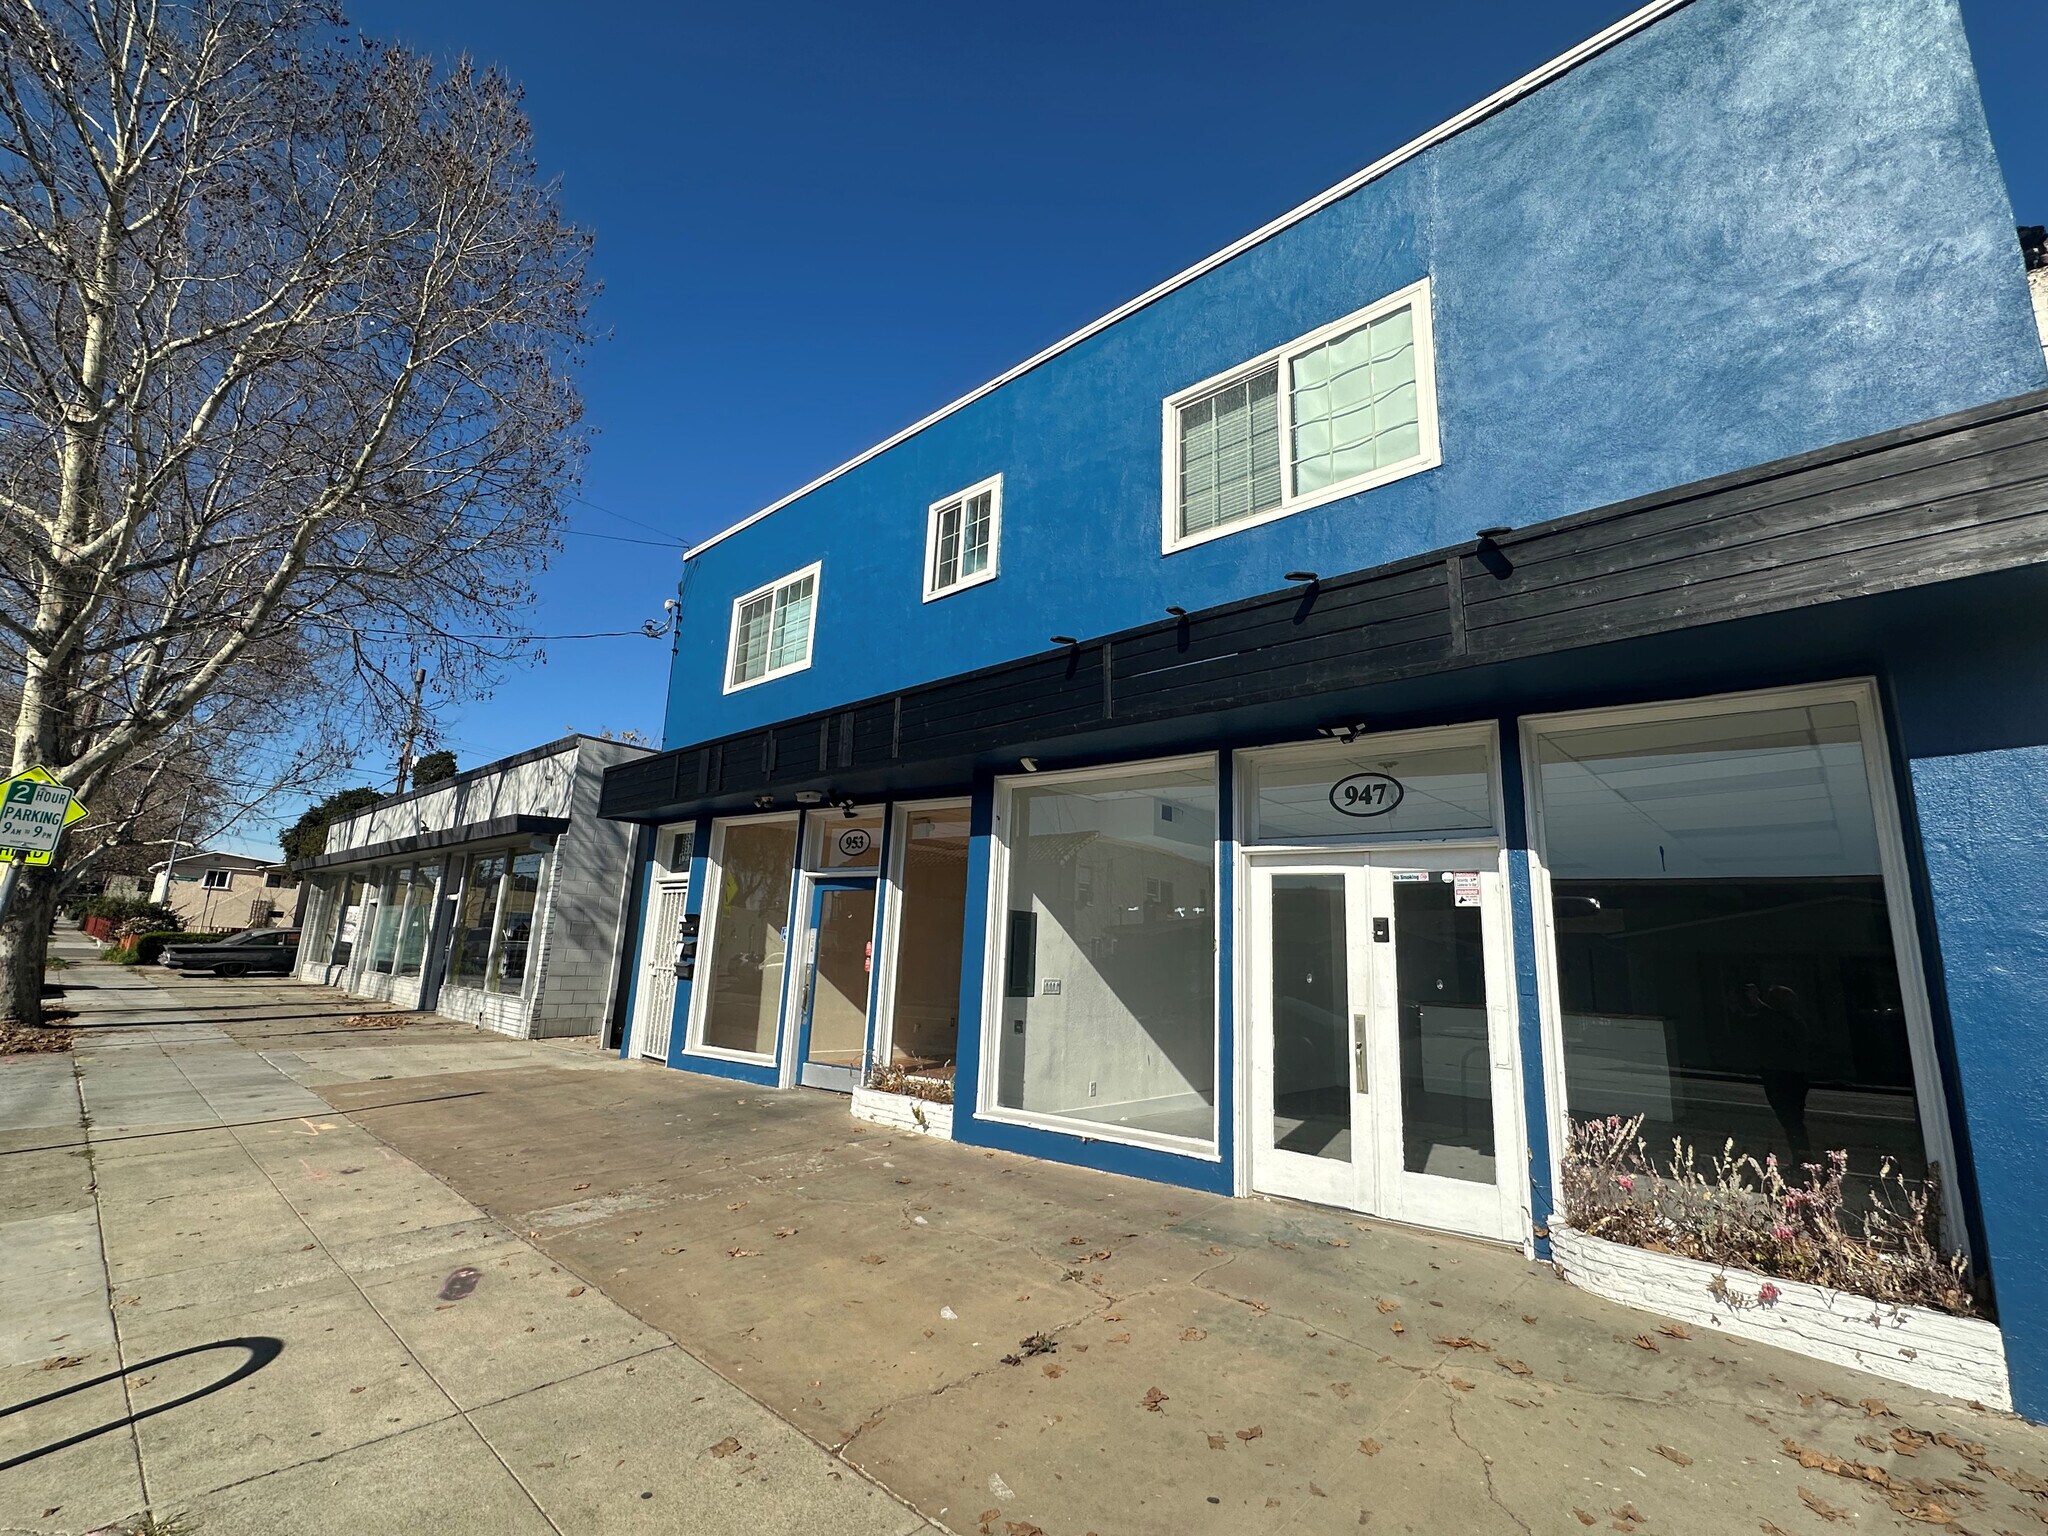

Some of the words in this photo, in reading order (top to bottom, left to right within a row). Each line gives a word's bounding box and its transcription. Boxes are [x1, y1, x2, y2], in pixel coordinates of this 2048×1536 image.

[13, 784, 30, 801] 2
[35, 791, 66, 804] HOUR
[1344, 783, 1387, 806] 947
[4, 806, 61, 826] PARKING
[845, 836, 863, 849] 953
